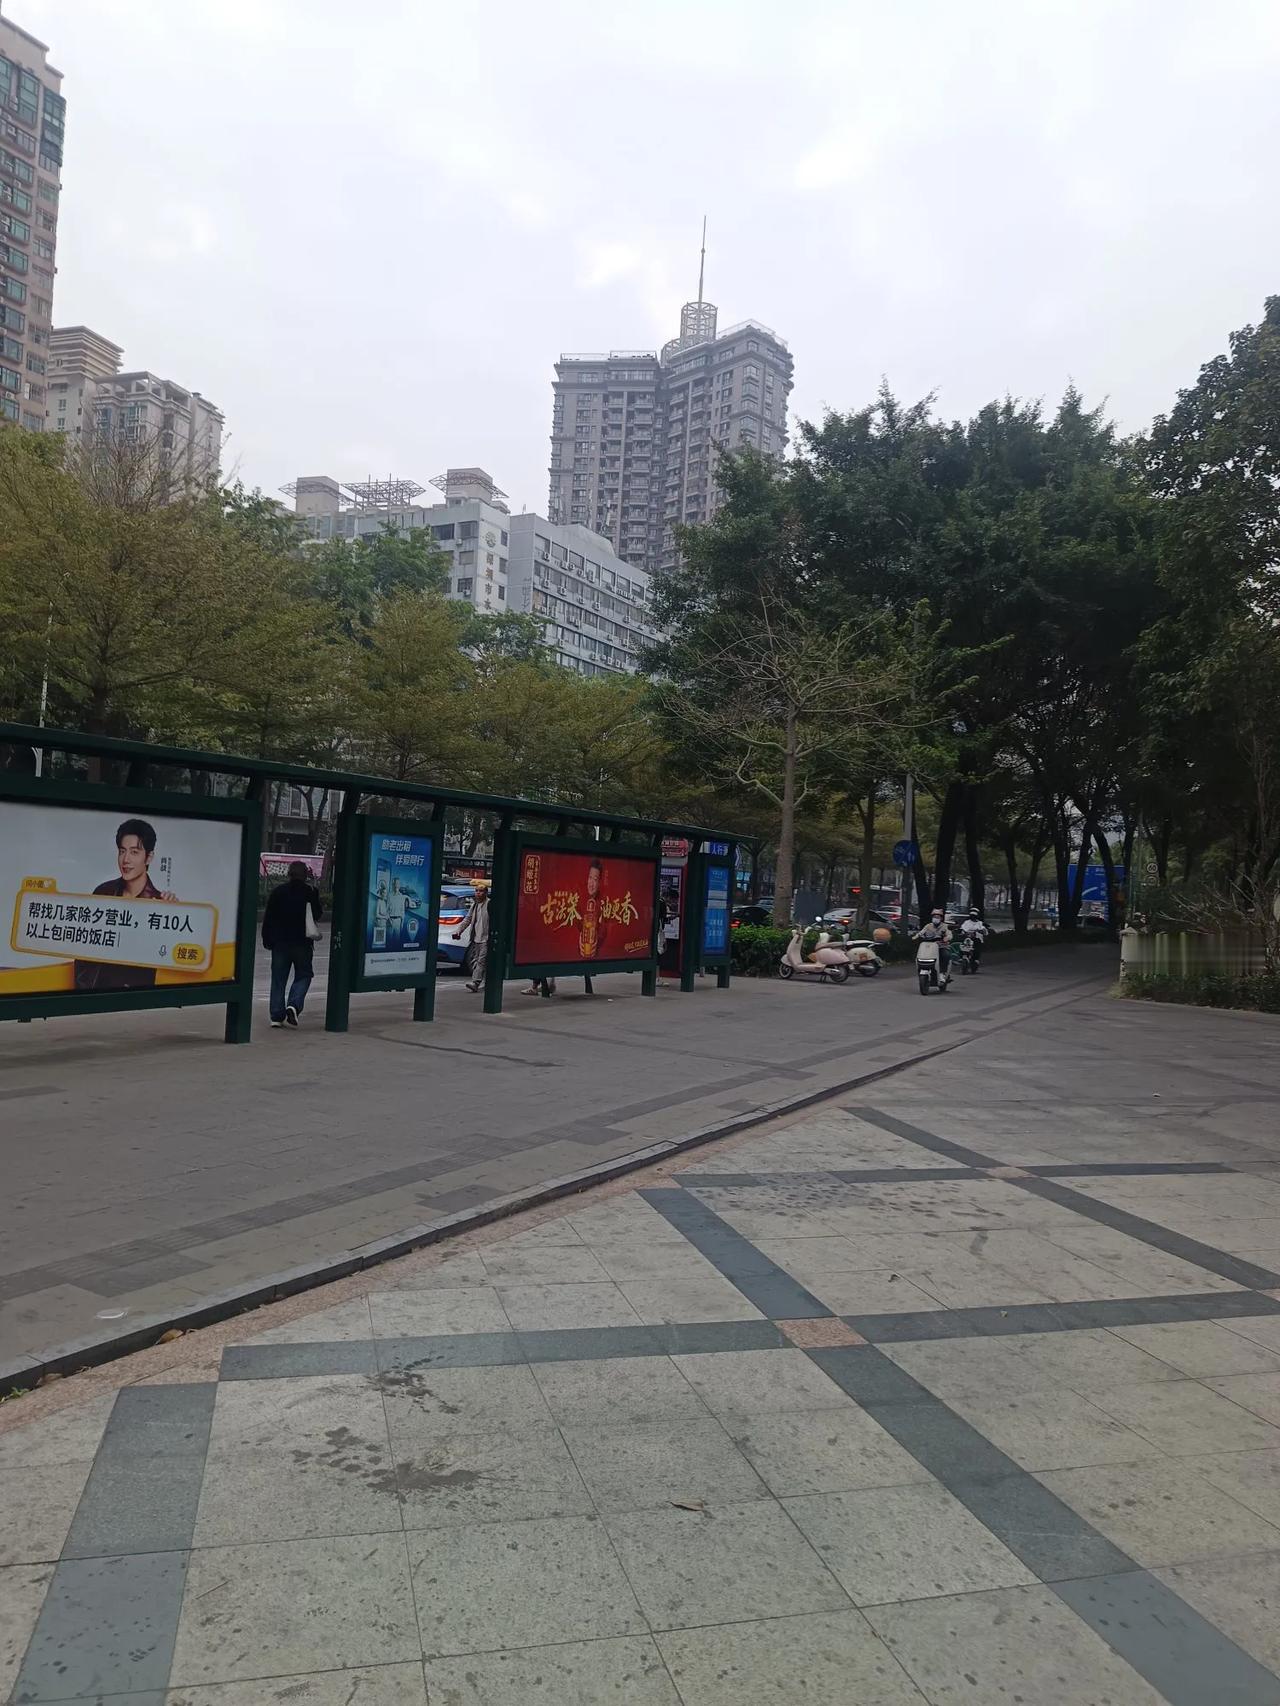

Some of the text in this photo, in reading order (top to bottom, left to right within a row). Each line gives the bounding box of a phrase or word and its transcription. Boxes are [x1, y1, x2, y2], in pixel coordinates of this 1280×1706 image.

[525, 857, 535, 891] 胡姬花
[28, 902, 193, 933] 帮找几家除夕营业，有10人
[25, 923, 116, 947] 以上包间的饭店
[177, 947, 199, 960] 搜索
